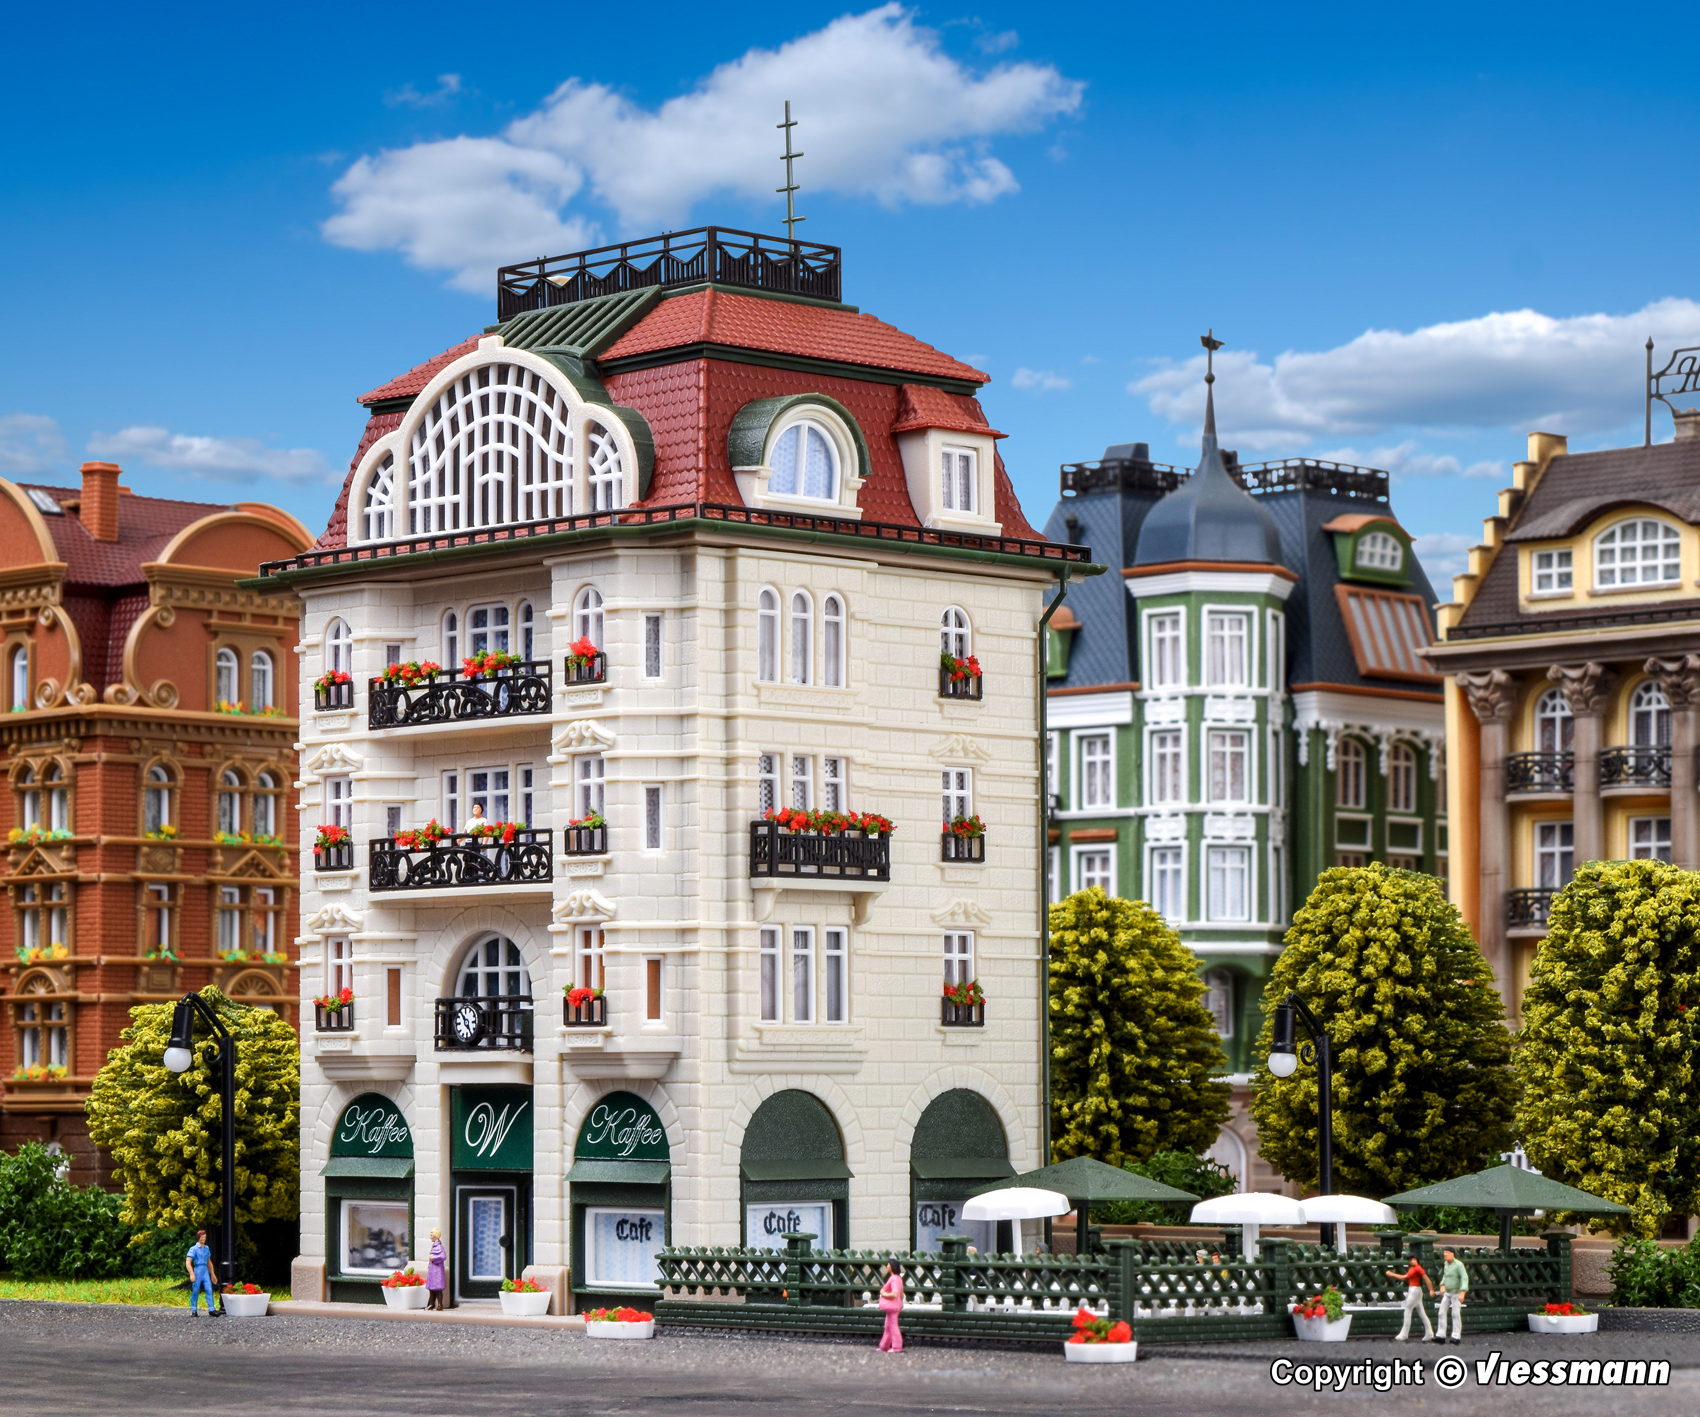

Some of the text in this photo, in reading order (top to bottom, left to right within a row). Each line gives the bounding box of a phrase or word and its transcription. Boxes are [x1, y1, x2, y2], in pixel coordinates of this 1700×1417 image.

[341, 1105, 408, 1154] Kaffee
[465, 1101, 528, 1157] W
[587, 1104, 662, 1156] Kaffee
